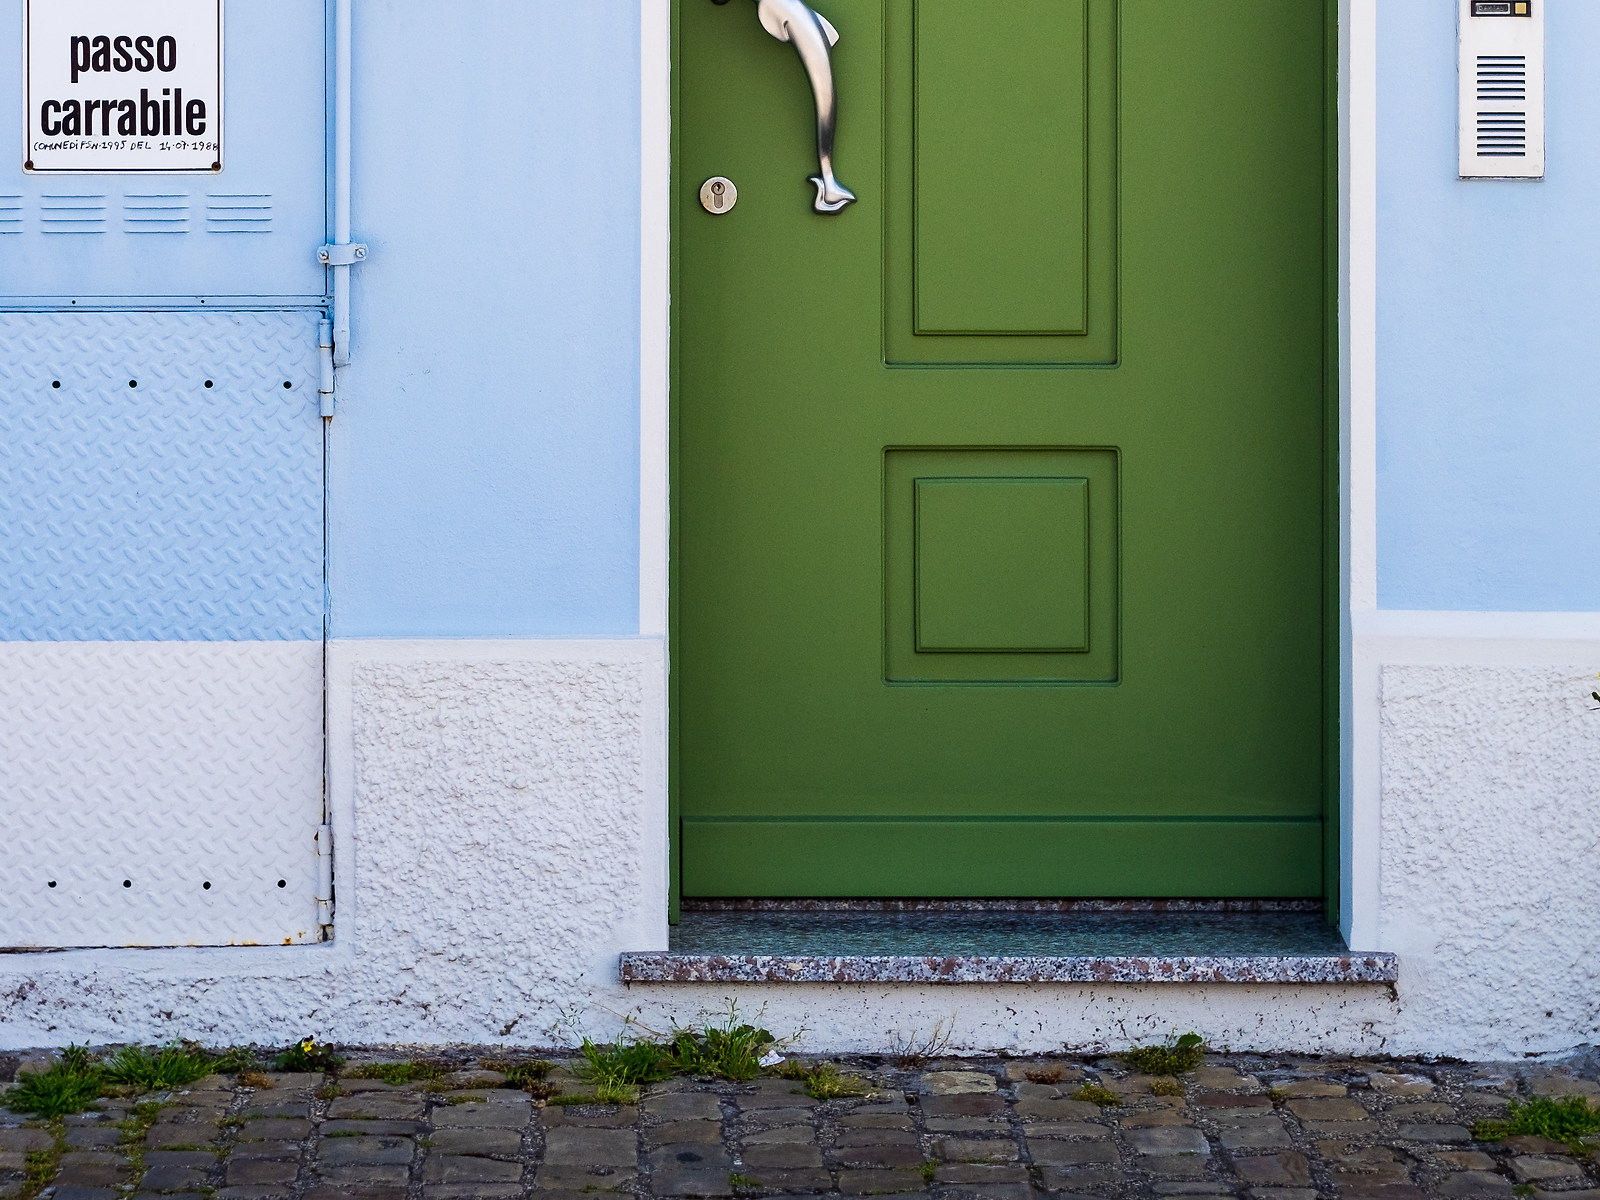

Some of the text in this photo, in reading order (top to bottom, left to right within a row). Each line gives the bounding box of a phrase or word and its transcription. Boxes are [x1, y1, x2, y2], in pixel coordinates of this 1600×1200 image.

[70, 35, 177, 83] passo
[41, 88, 206, 136] carrabile
[130, 141, 152, 151] DEL
